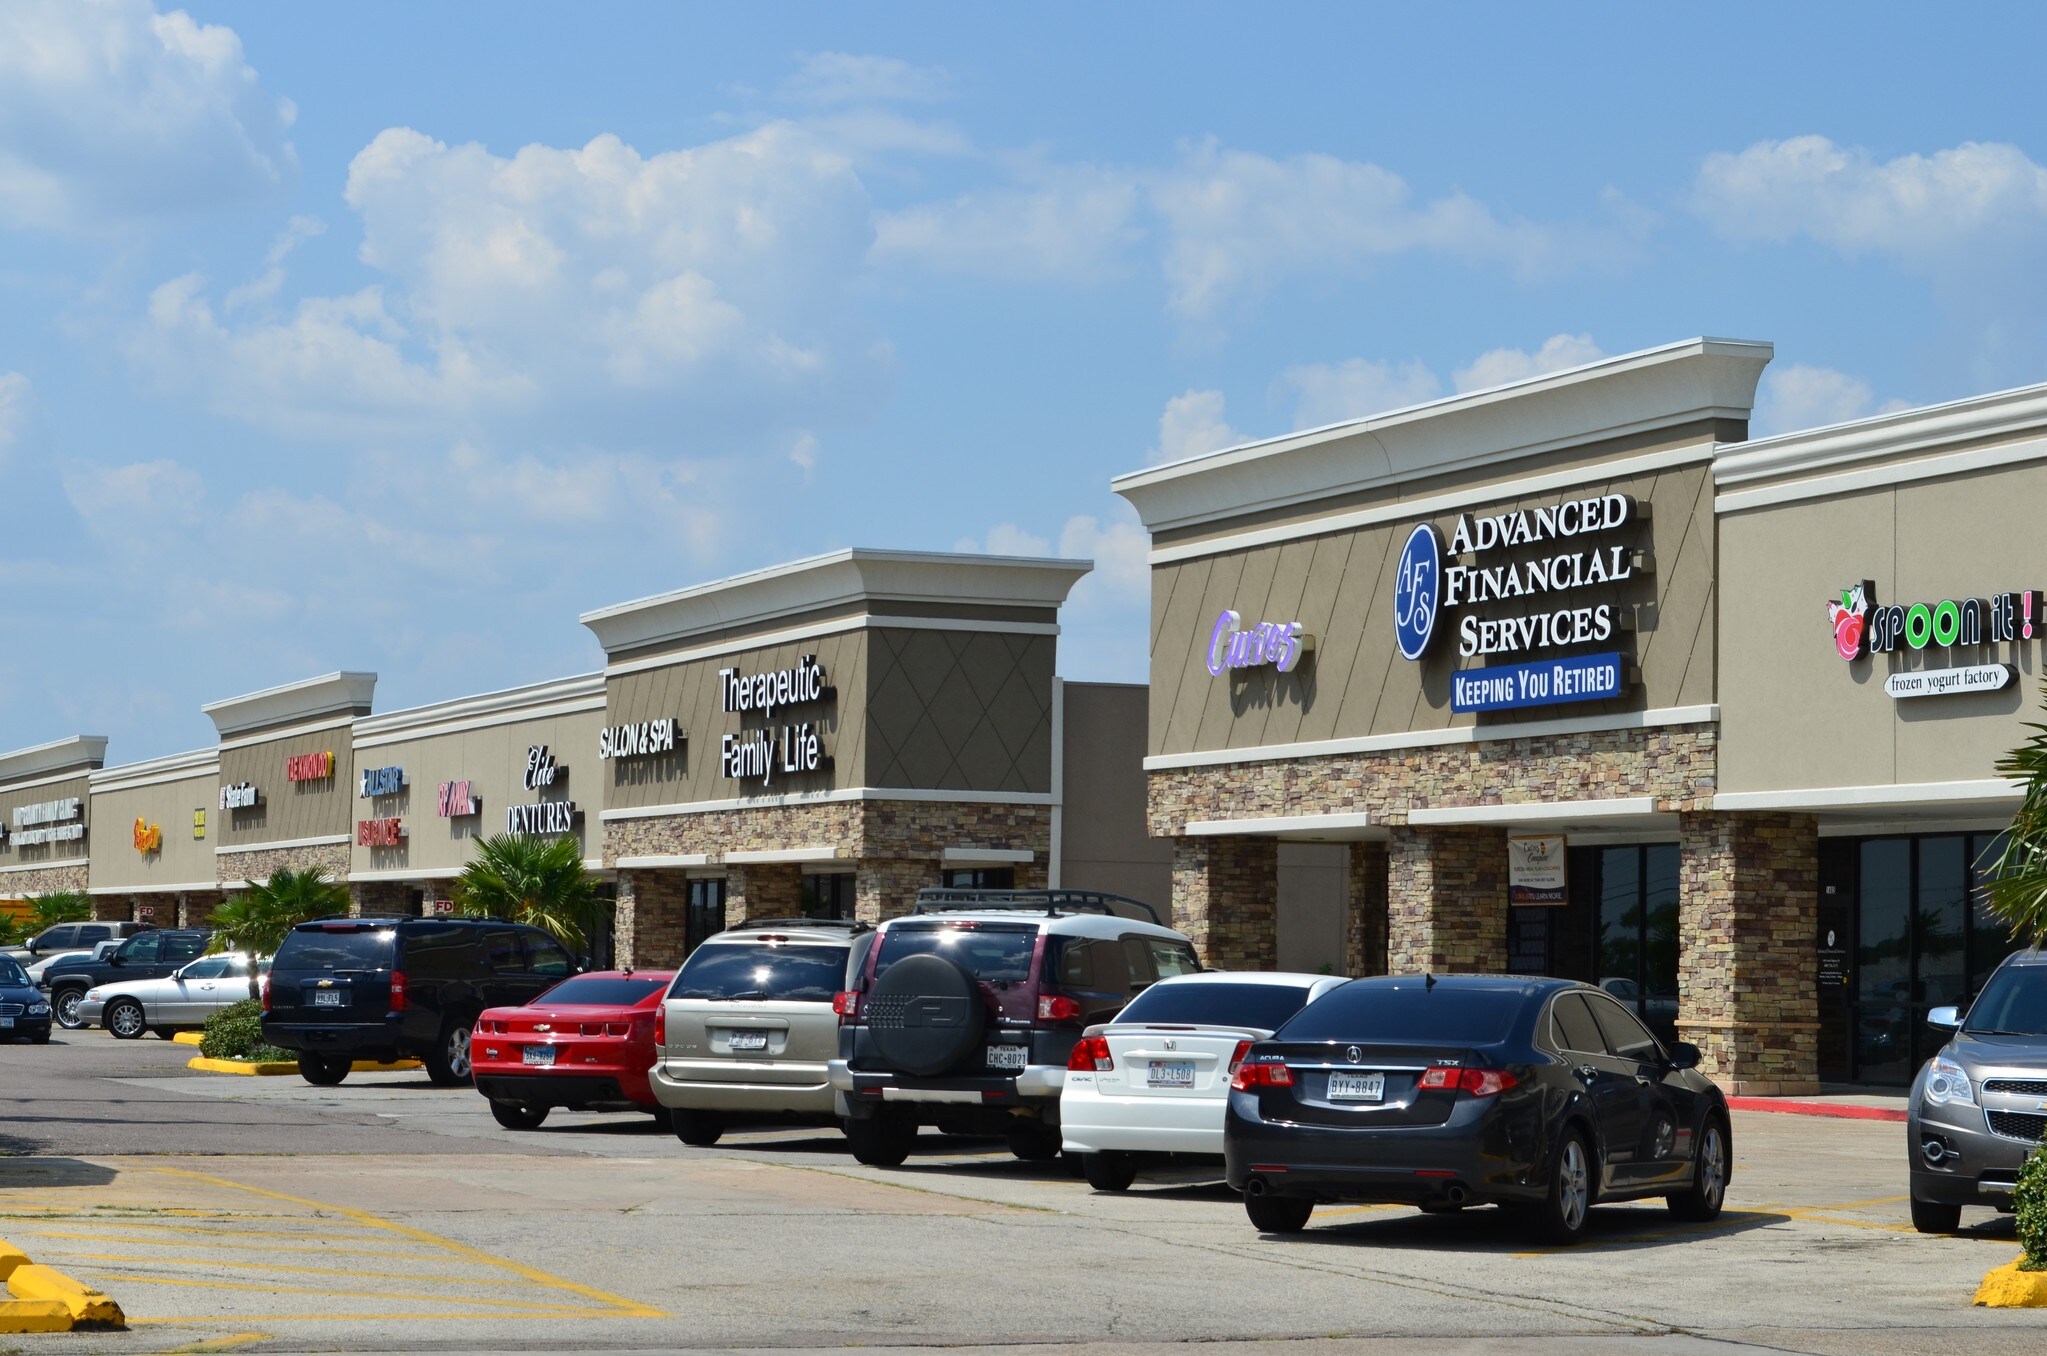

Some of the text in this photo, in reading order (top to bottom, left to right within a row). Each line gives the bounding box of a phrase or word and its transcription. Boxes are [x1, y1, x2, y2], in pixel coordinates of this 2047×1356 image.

[1448, 493, 1628, 556] ADVANCED
[1444, 545, 1632, 607] FINANCIAL
[1459, 604, 1612, 658] SERVICES
[719, 655, 823, 719] Therapeutic
[1455, 675, 1514, 707] KEEPING
[1553, 664, 1615, 696] RETIRED
[1891, 668, 2001, 694] frozen yogurt factory
[598, 717, 676, 760] SALON & SPA
[722, 722, 819, 787] Family Life
[366, 767, 401, 798] ALLSTAR
[523, 744, 557, 792] Elite
[225, 783, 241, 810] State
[357, 818, 401, 848] INSURANCE
[506, 800, 573, 836] DENTURES
[140, 907, 153, 915] FD
[436, 900, 453, 912] FD
[1436, 1059, 1460, 1067] TSX
